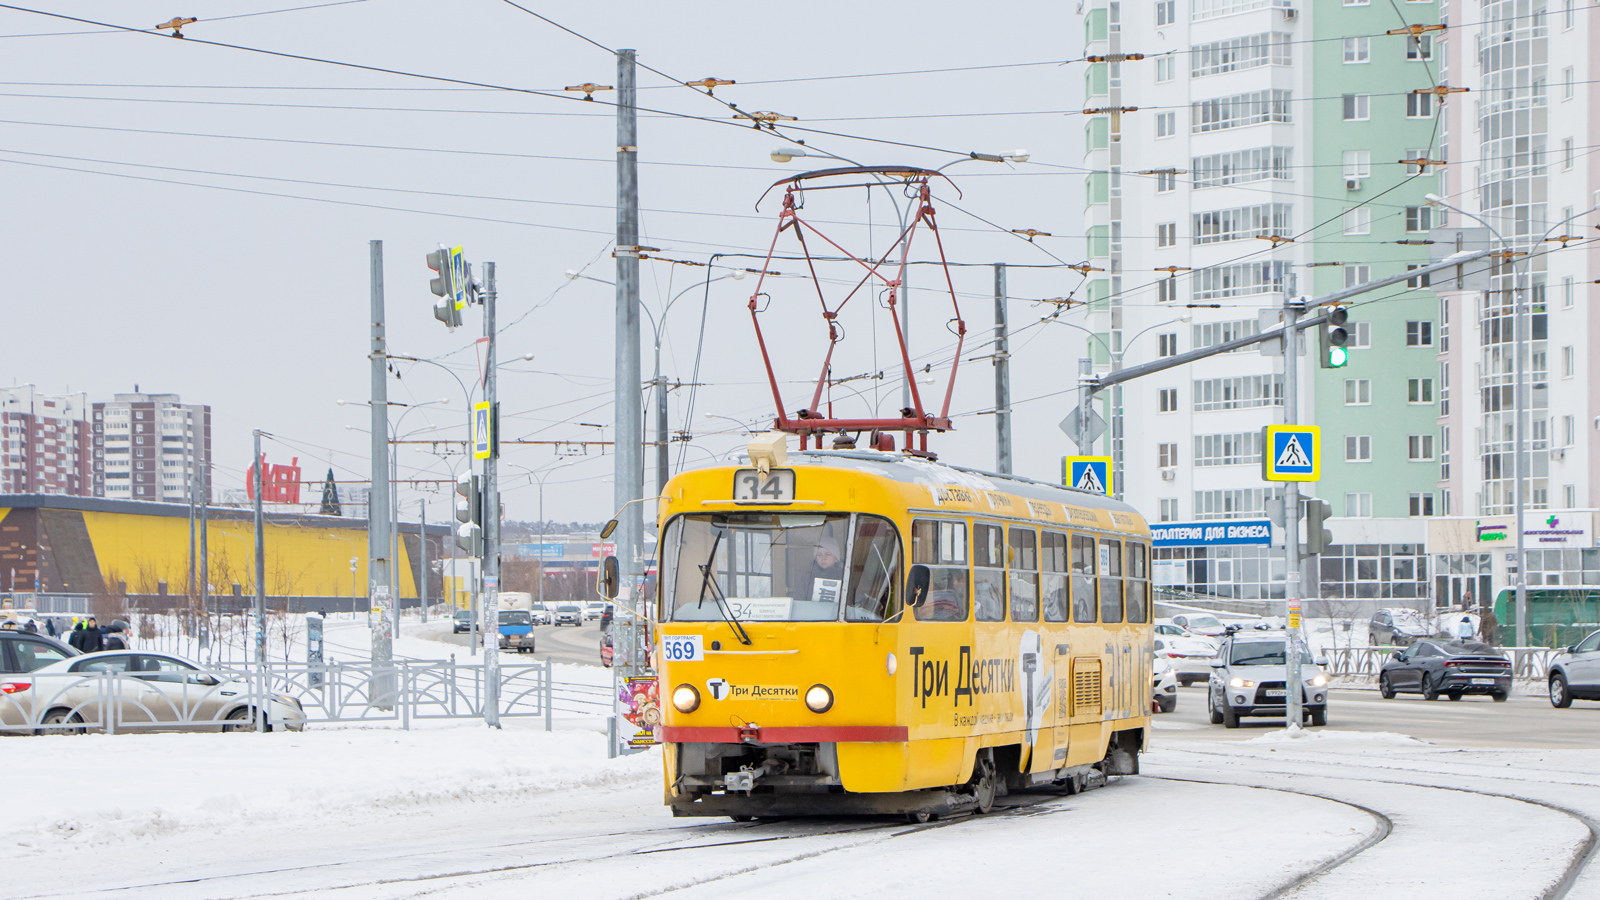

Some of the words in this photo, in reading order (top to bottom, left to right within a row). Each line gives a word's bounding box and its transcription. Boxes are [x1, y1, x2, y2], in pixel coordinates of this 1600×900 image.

[741, 476, 783, 499] 34
[1150, 527, 1202, 540] ХГАЛТЕРИЯ
[1204, 526, 1225, 541] ДЛЯ
[1227, 525, 1270, 539] БИЗНЕСА
[732, 602, 752, 619] 34
[665, 641, 695, 660] 569
[909, 646, 948, 708] Три
[954, 645, 1015, 707] Десятки
[729, 685, 749, 697] Три
[751, 685, 798, 697] Десятки
